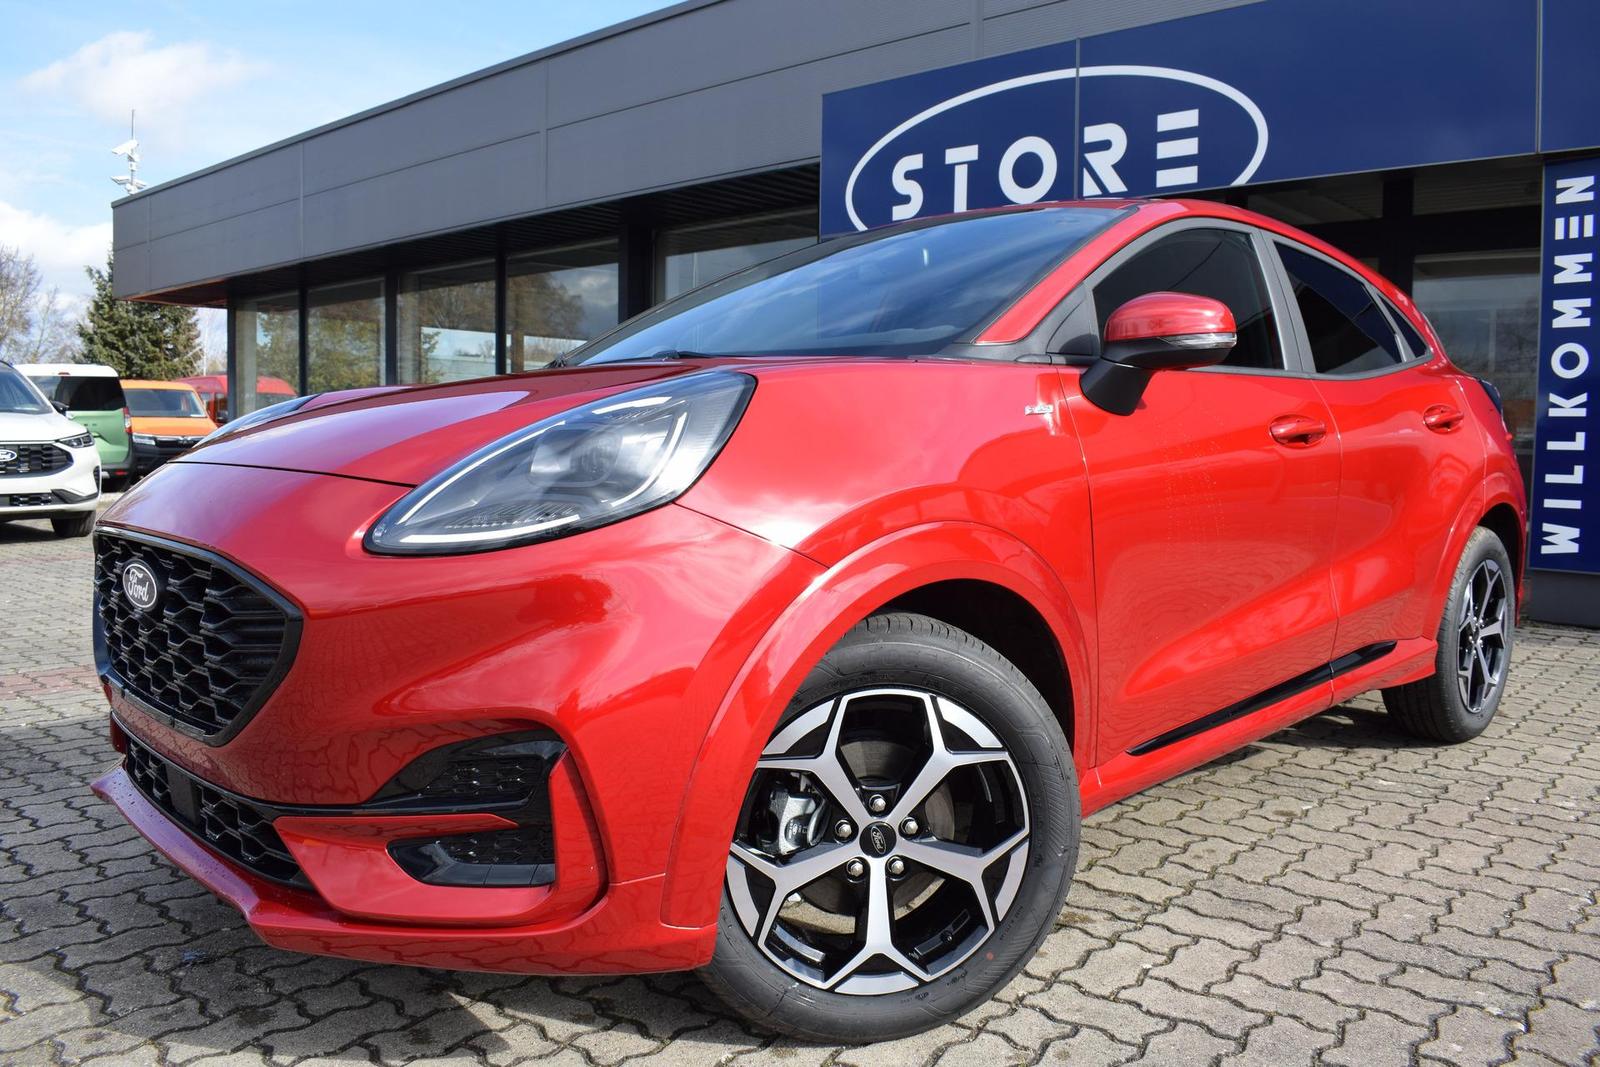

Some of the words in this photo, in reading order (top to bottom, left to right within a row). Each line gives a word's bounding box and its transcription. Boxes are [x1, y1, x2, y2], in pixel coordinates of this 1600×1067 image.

[892, 108, 1200, 221] STORE
[1541, 175, 1596, 555] WILLKOMMEN
[127, 567, 150, 602] Ford
